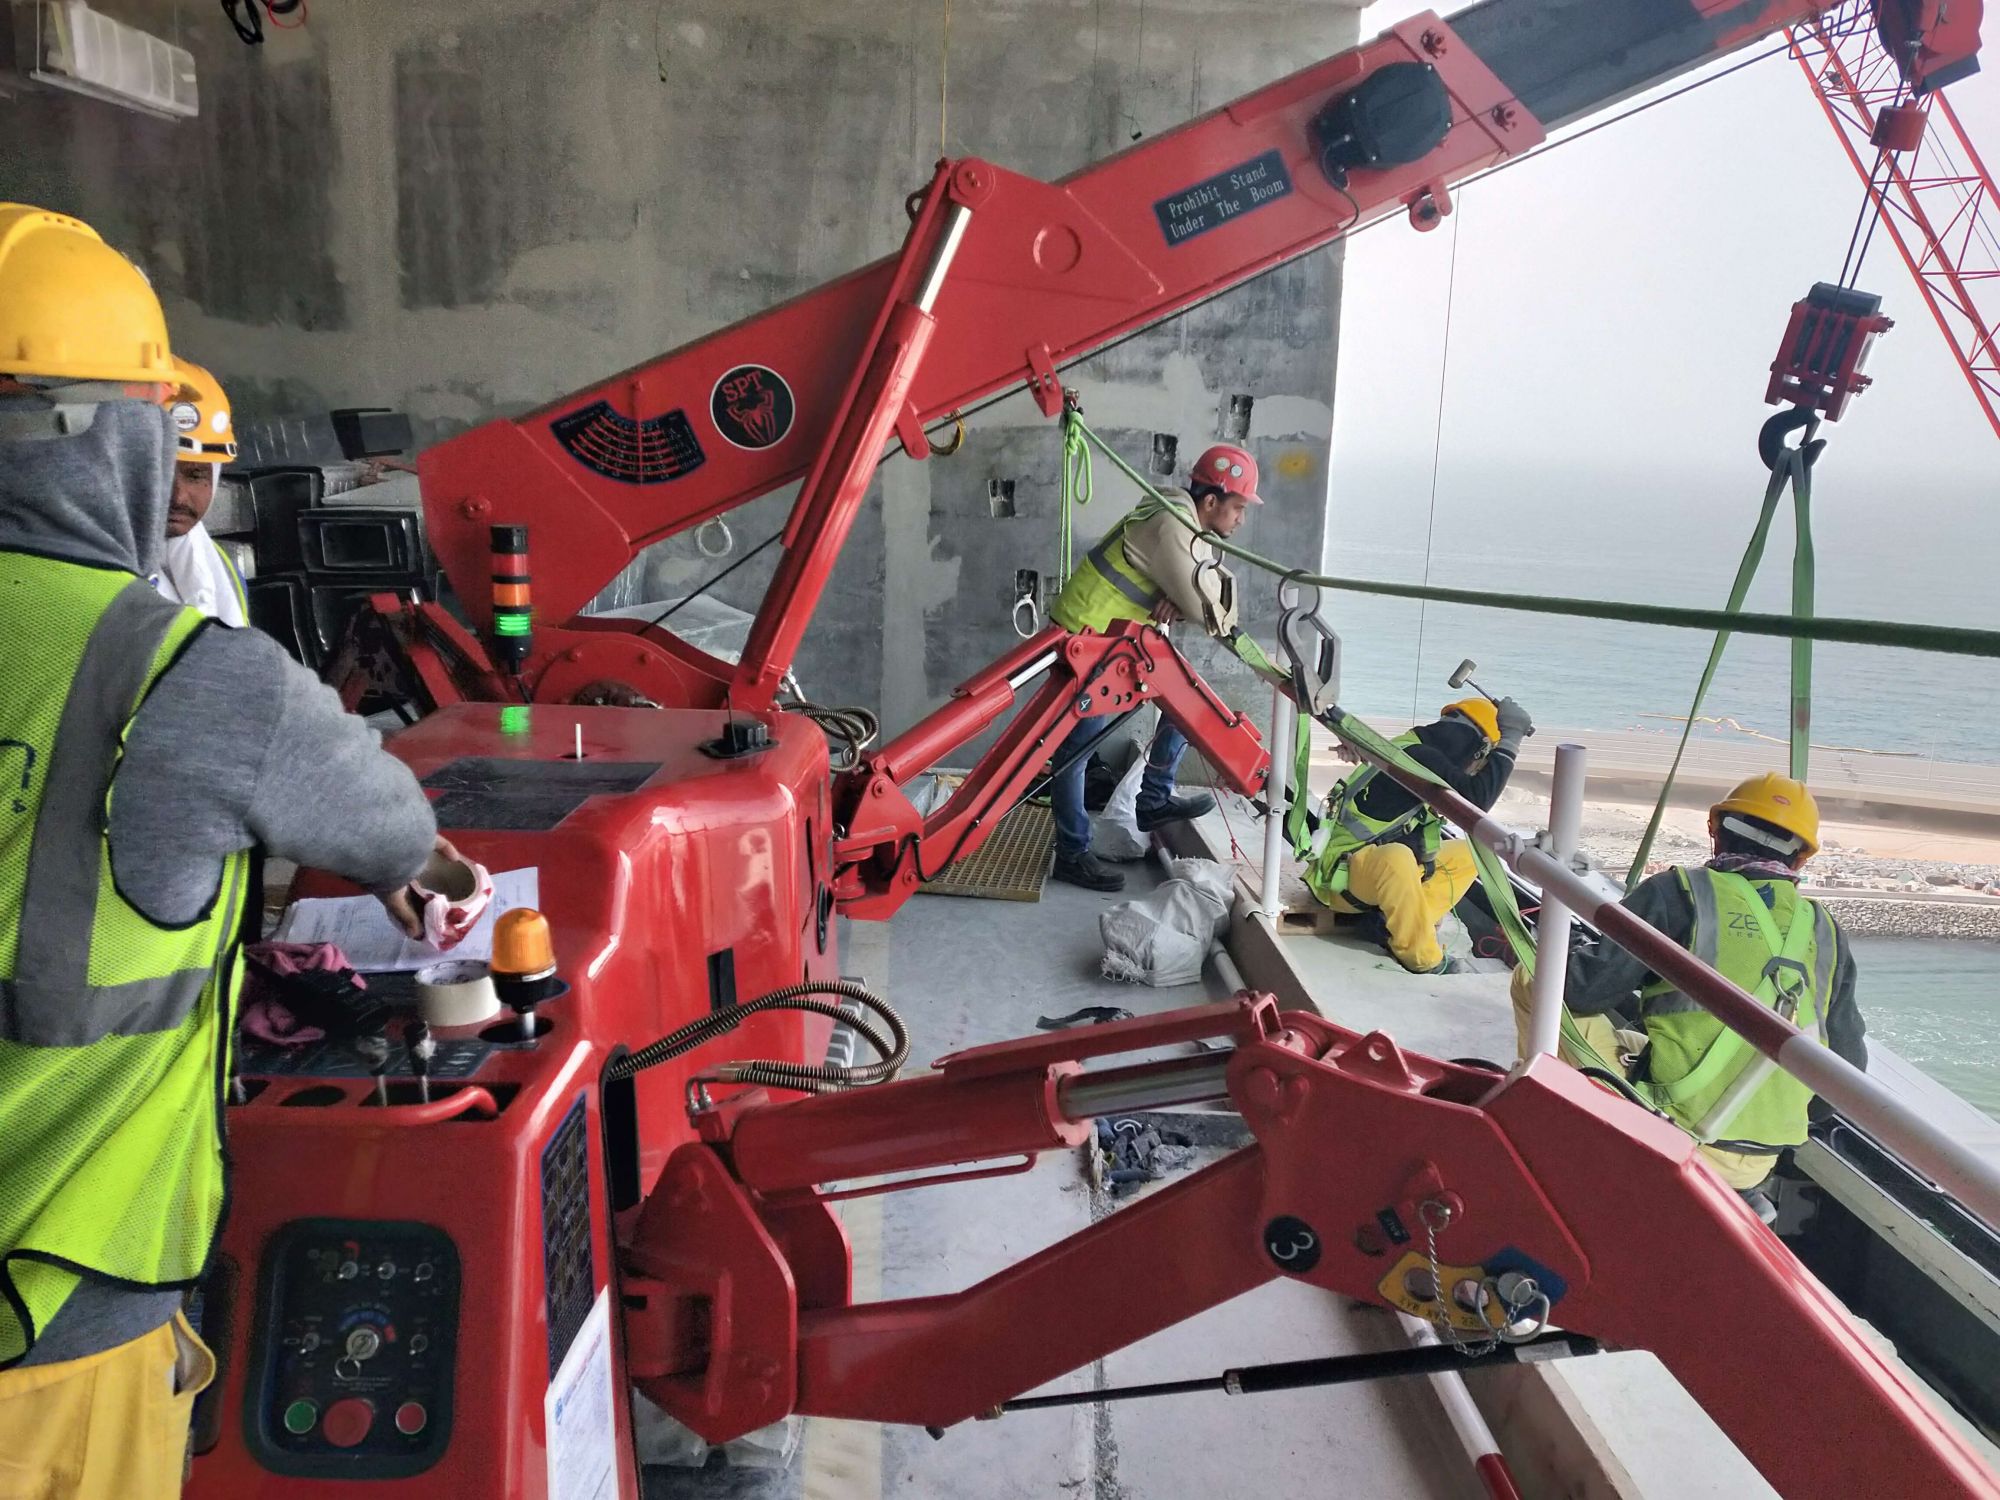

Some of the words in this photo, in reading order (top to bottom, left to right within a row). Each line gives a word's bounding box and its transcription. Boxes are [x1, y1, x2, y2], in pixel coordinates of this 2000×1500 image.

[1168, 185, 1220, 219] Prohibit
[1230, 162, 1267, 190] Stand
[1170, 214, 1204, 239] Under
[1215, 199, 1240, 218] The
[1249, 179, 1285, 203] Boom
[721, 370, 763, 402] SPT
[1080, 698, 1092, 711] 4
[1270, 1231, 1314, 1260] 3
